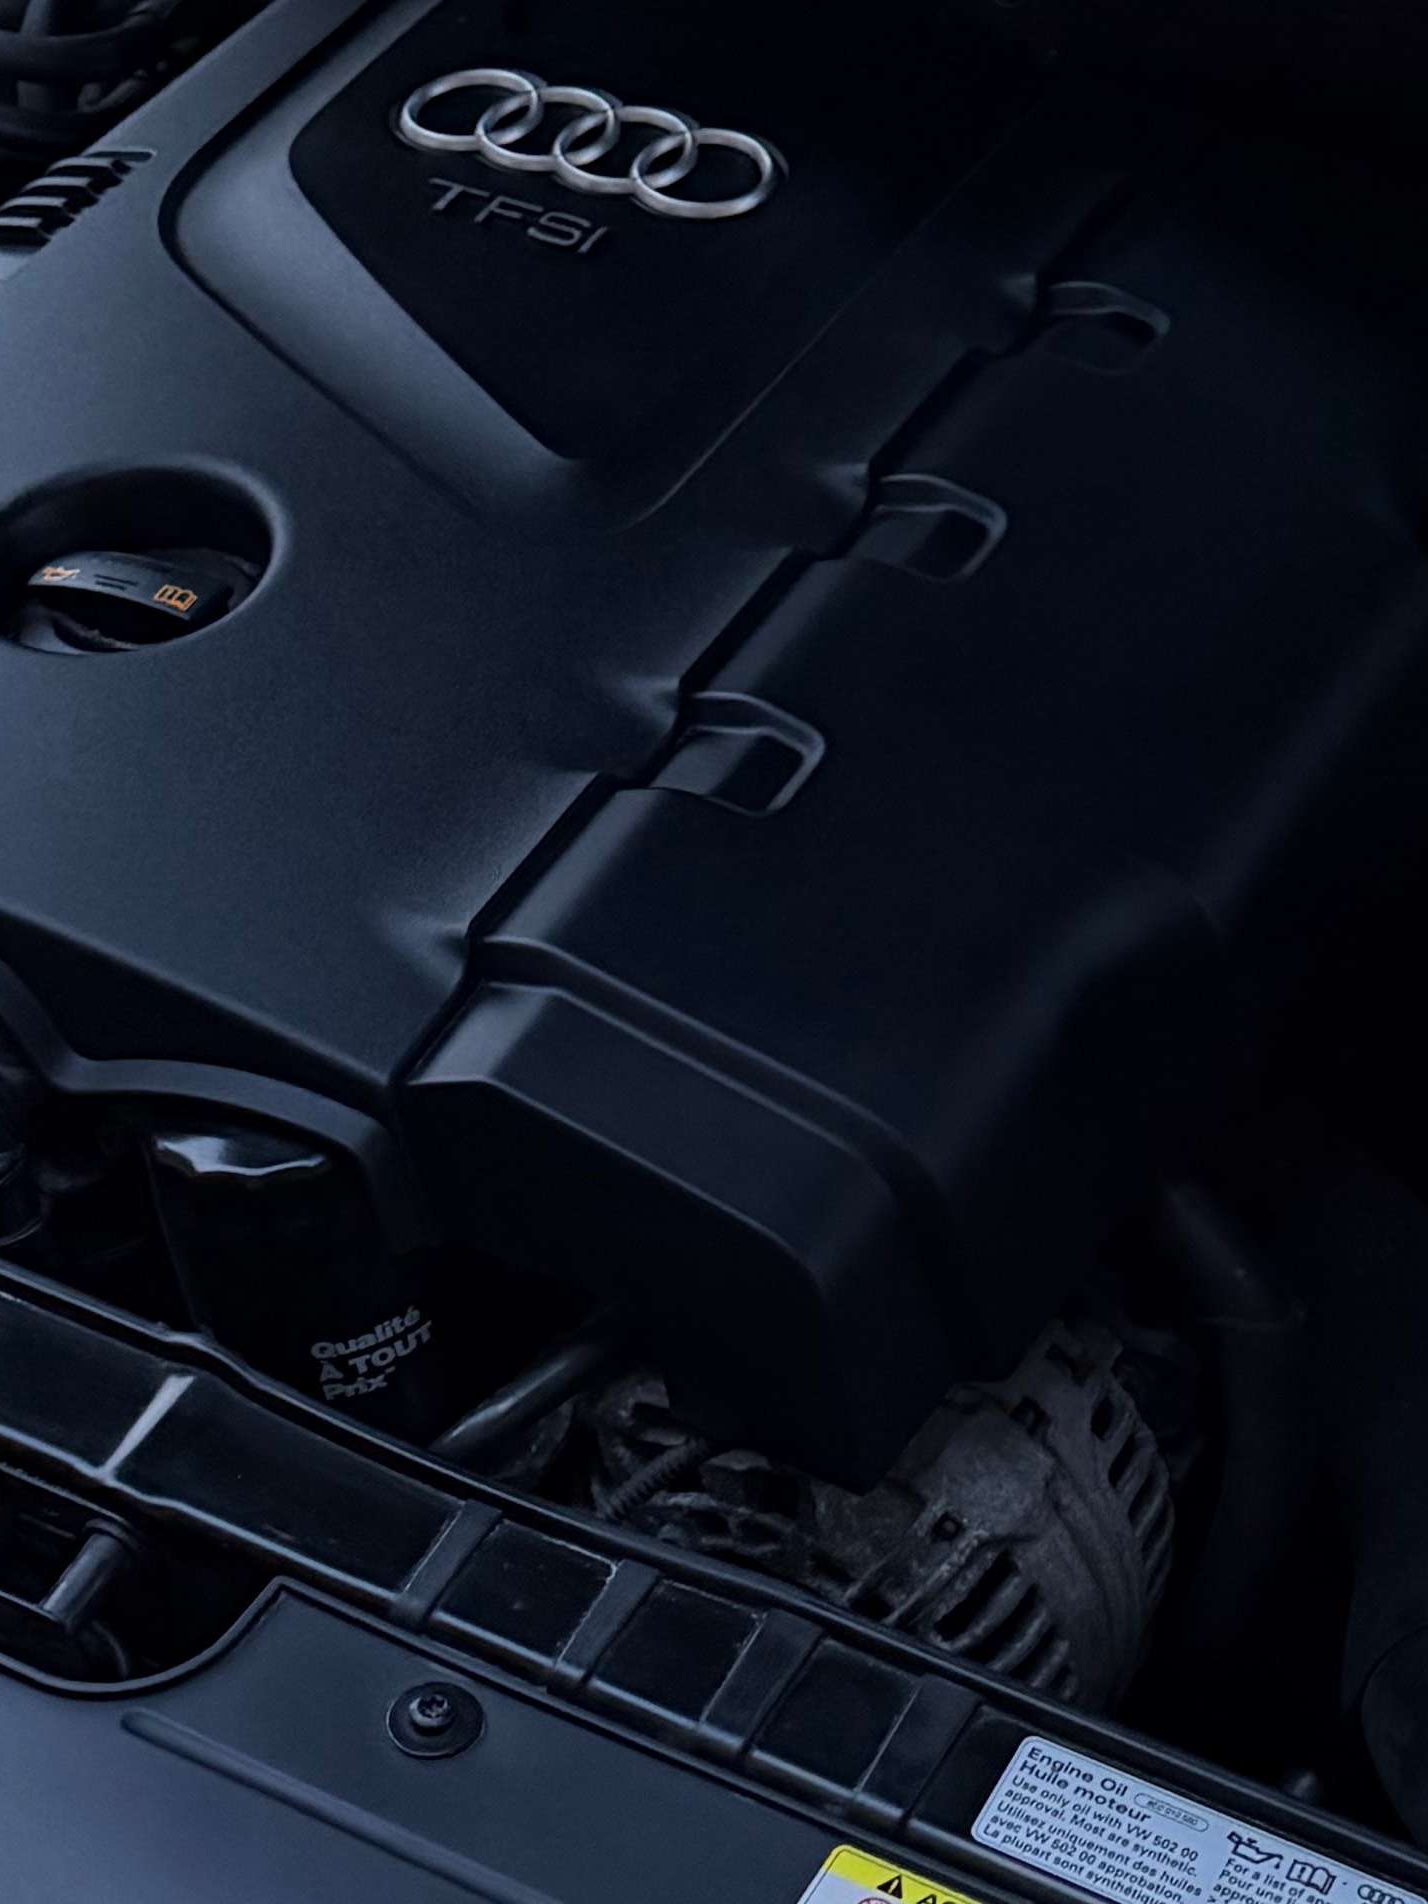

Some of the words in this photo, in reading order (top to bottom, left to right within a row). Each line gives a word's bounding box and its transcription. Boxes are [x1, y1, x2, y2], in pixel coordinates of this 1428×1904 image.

[426, 177, 610, 256] TFSI
[310, 1304, 421, 1359] Qualité
[347, 1319, 433, 1374] TOUT
[321, 1372, 390, 1402] Prix
[1019, 1759, 1068, 1789] Huile
[1073, 1786, 1151, 1822] moteur
[1027, 1746, 1093, 1783] Engine
[1099, 1777, 1128, 1796] Oil
[1004, 1789, 1065, 1821] approval.
[1069, 1814, 1105, 1837] Most
[1107, 1832, 1130, 1847] are
[1132, 1843, 1196, 1876] synthetic.
[1011, 1774, 1038, 1794] Use
[1039, 1789, 1070, 1808] only
[1071, 1803, 1091, 1815] oil
[1092, 1810, 1122, 1829] with
[1126, 1823, 1152, 1840] VW
[1152, 1834, 1178, 1853] 502
[1180, 1847, 1198, 1861] 00
[982, 1823, 1000, 1839] La
[1000, 1834, 1051, 1861] plupart
[1053, 1856, 1084, 1875] sont
[989, 1815, 1022, 1833] avec
[1025, 1826, 1051, 1844] VW
[1050, 1838, 1077, 1857] 502
[1078, 1850, 1096, 1865] 00
[1097, 1861, 1183, 1904] approbation.
[996, 1800, 1045, 1829] Utilisez
[1047, 1824, 1130, 1865] uniquement
[1131, 1860, 1157, 1877] des
[1159, 1870, 1201, 1896] huiles
[1218, 1869, 1253, 1890] Pour
[1255, 1886, 1281, 1904] une
[1224, 1857, 1249, 1874] For
[1251, 1871, 1261, 1880] a
[1263, 1874, 1286, 1891] list
[1287, 1886, 1305, 1898] of
